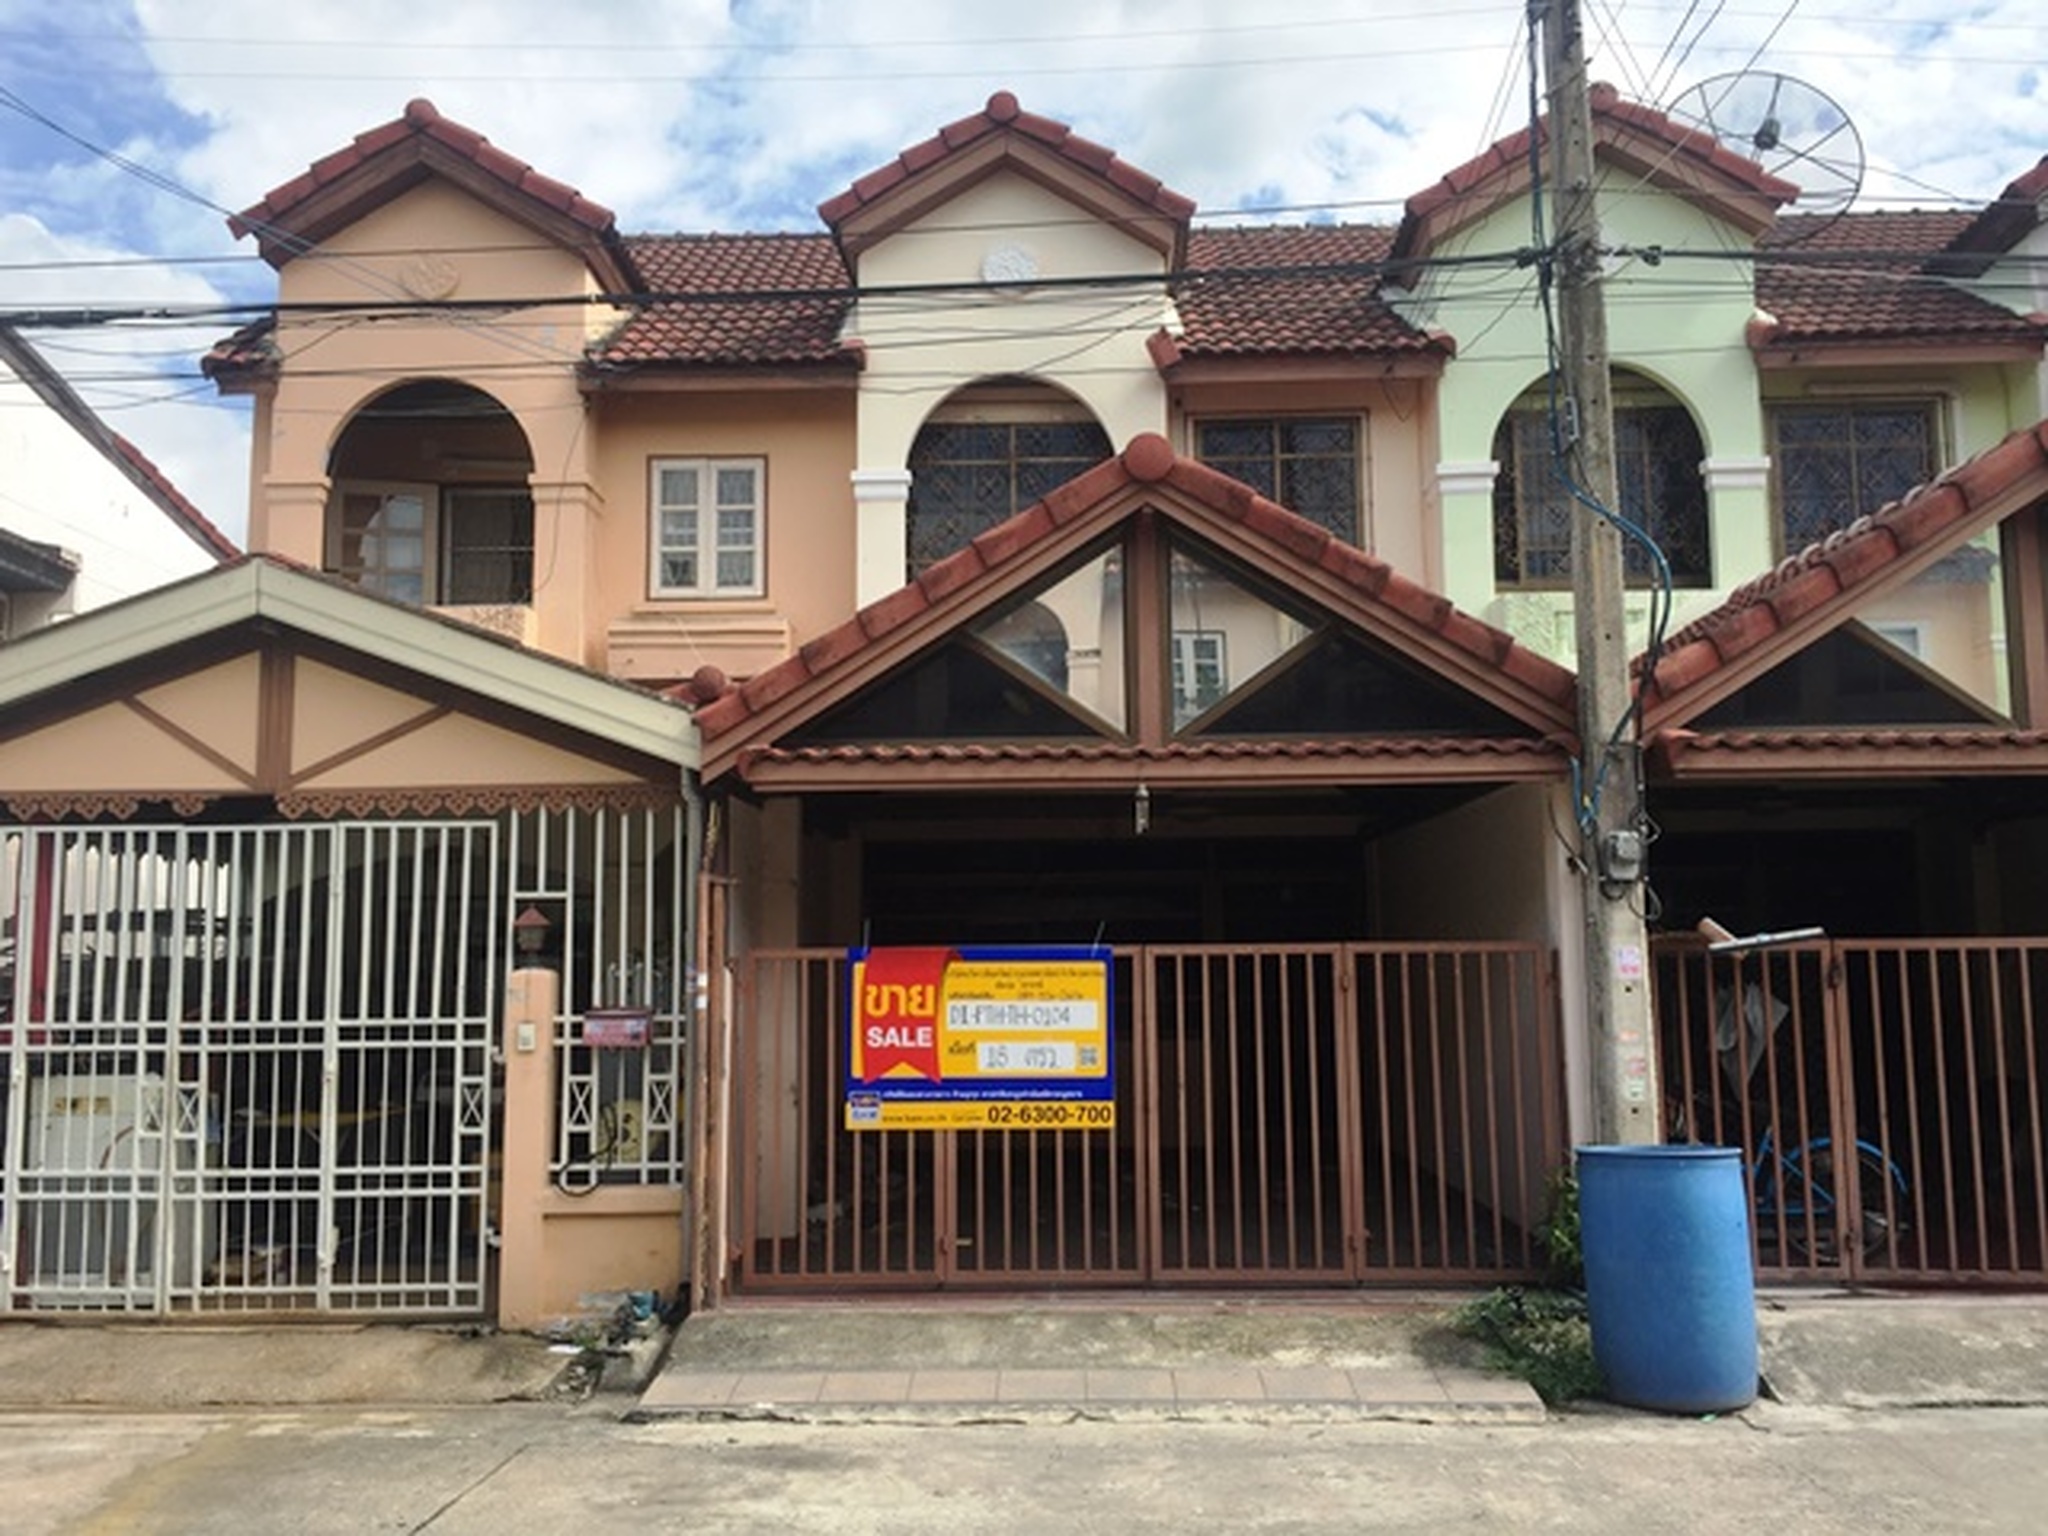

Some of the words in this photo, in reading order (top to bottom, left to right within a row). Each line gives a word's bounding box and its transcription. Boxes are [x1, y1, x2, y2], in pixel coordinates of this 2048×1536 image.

[865, 984, 935, 1018] ขาย
[866, 1026, 933, 1048] SALE
[987, 1105, 1112, 1124] 02-6300-700
